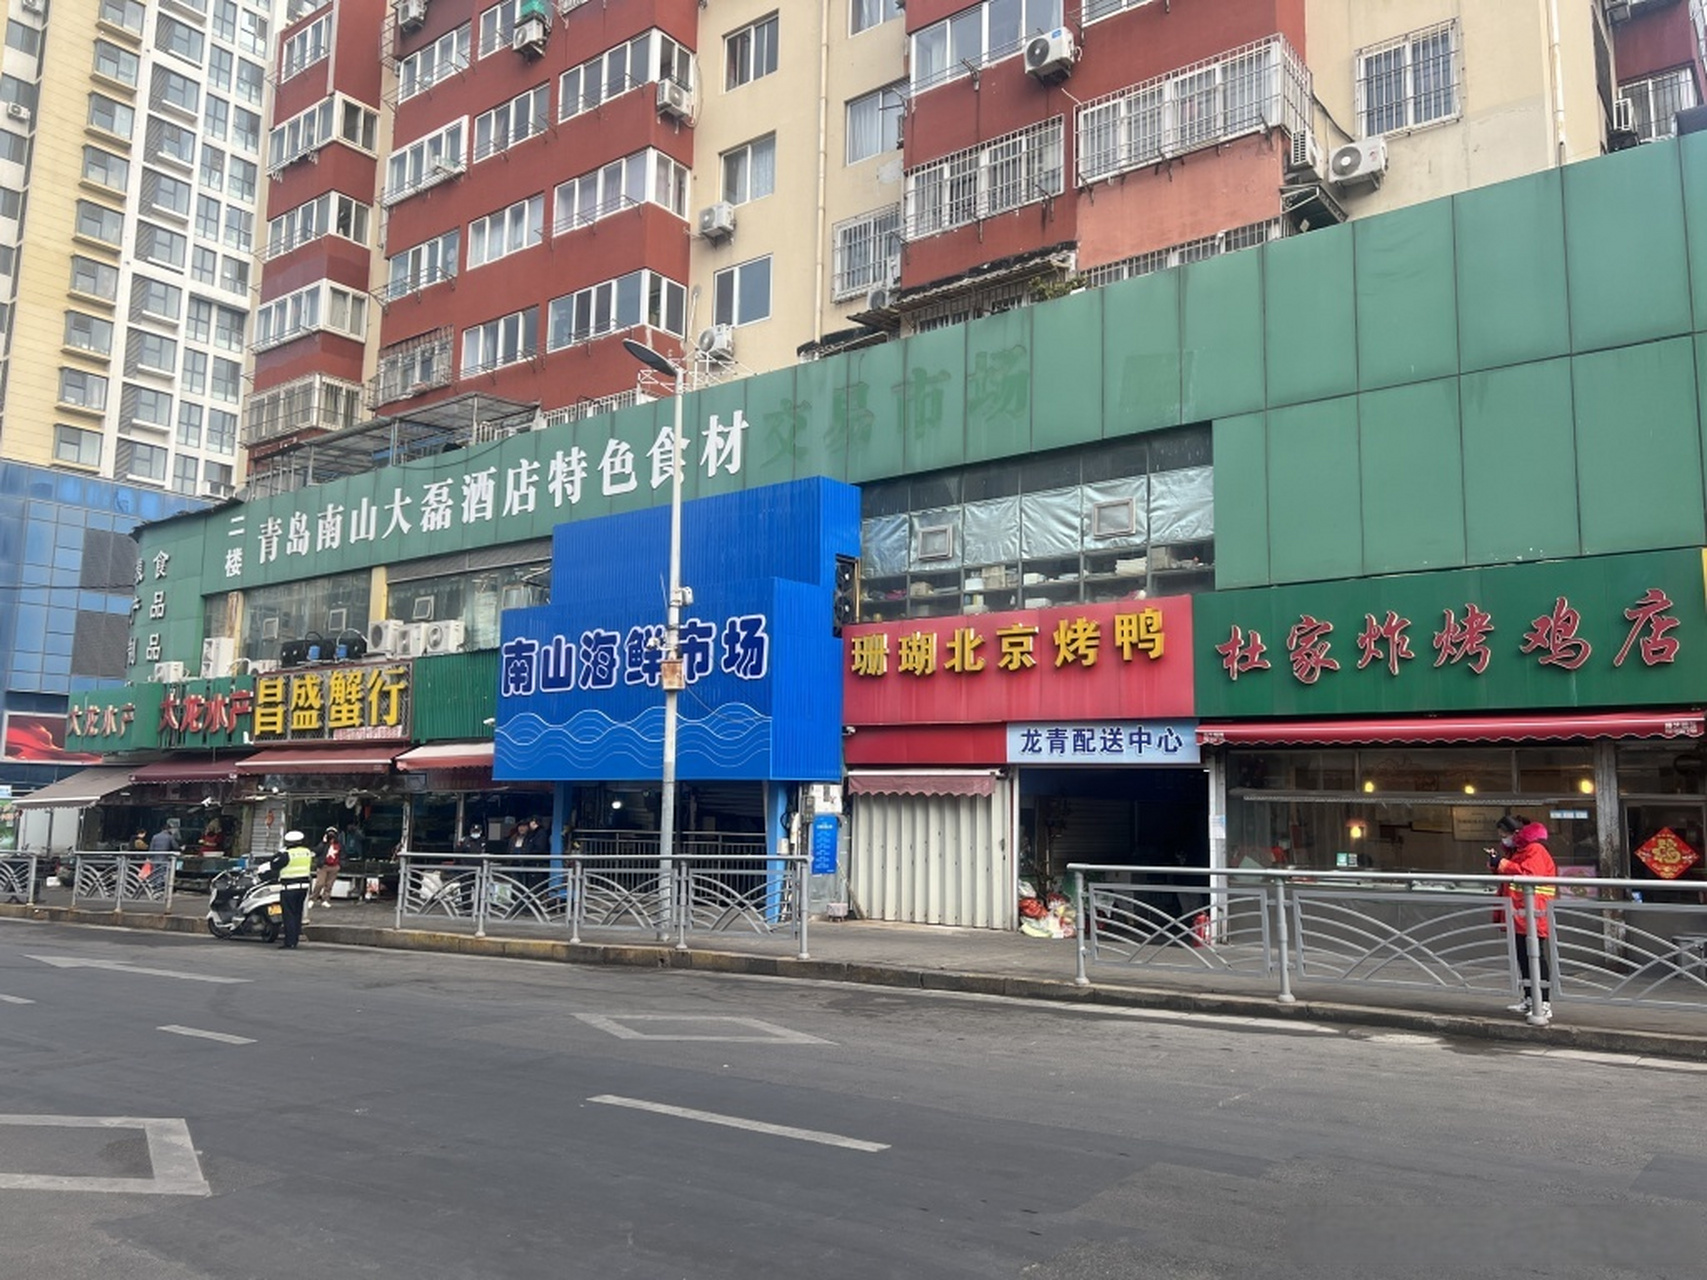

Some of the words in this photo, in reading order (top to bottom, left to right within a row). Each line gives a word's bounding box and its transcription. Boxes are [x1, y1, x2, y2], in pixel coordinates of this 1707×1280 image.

[257, 409, 750, 566] 青岛南山大磊酒店特色食材
[224, 516, 245, 578] 二楼
[501, 614, 770, 697] 南山海鲜市场
[850, 608, 1165, 676] 珊瑚北京烤鸭
[1216, 588, 1680, 683] 杜家炸烤鸡店
[254, 667, 406, 735] 昌盛蟹行
[1021, 726, 1183, 755] 龙青配送中心
